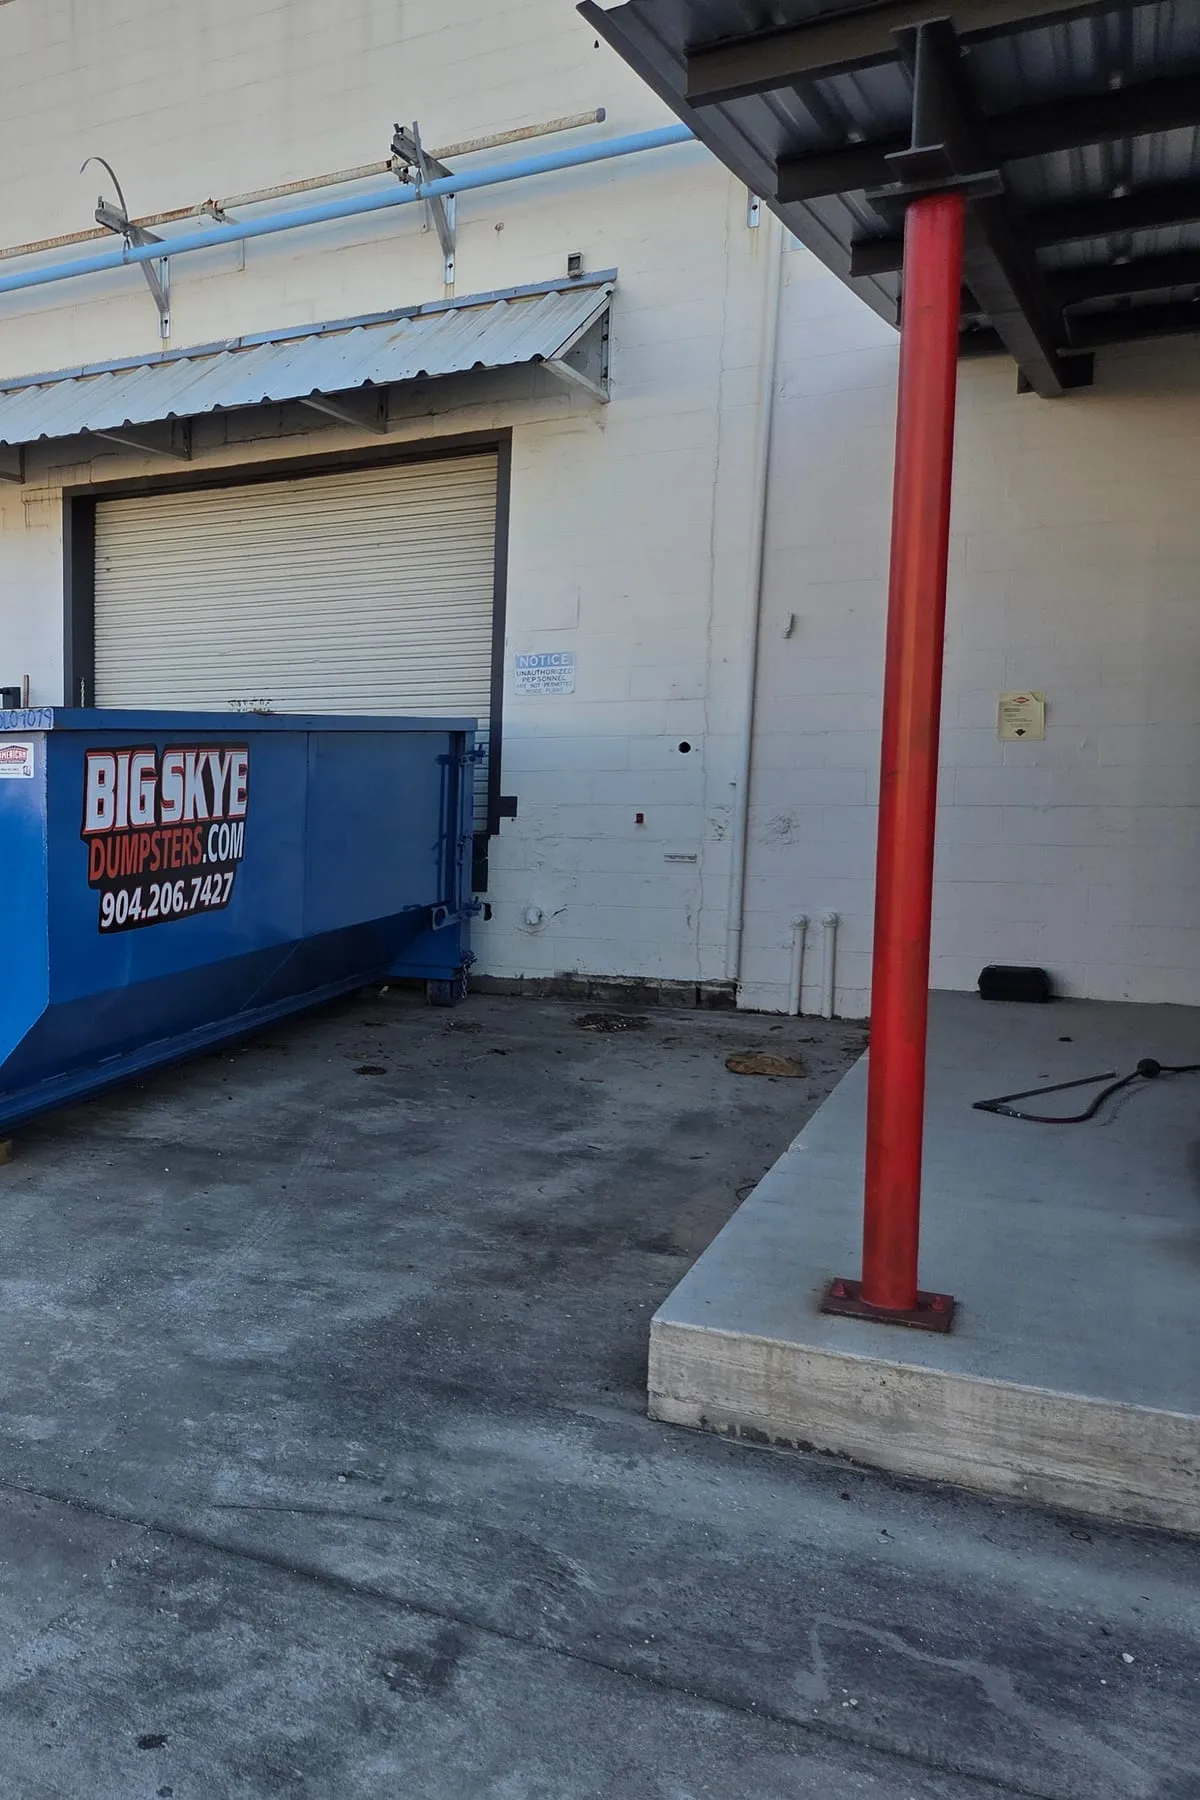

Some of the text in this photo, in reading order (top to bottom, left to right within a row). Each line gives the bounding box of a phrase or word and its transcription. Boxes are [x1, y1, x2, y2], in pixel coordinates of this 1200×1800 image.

[516, 668, 573, 677] UNAUTHORIZED
[519, 653, 569, 667] NOTICE
[83, 748, 249, 835] BIG SKYE
[89, 821, 245, 881] DUMPSTERS.COM
[101, 872, 234, 928] 904.206.7427
